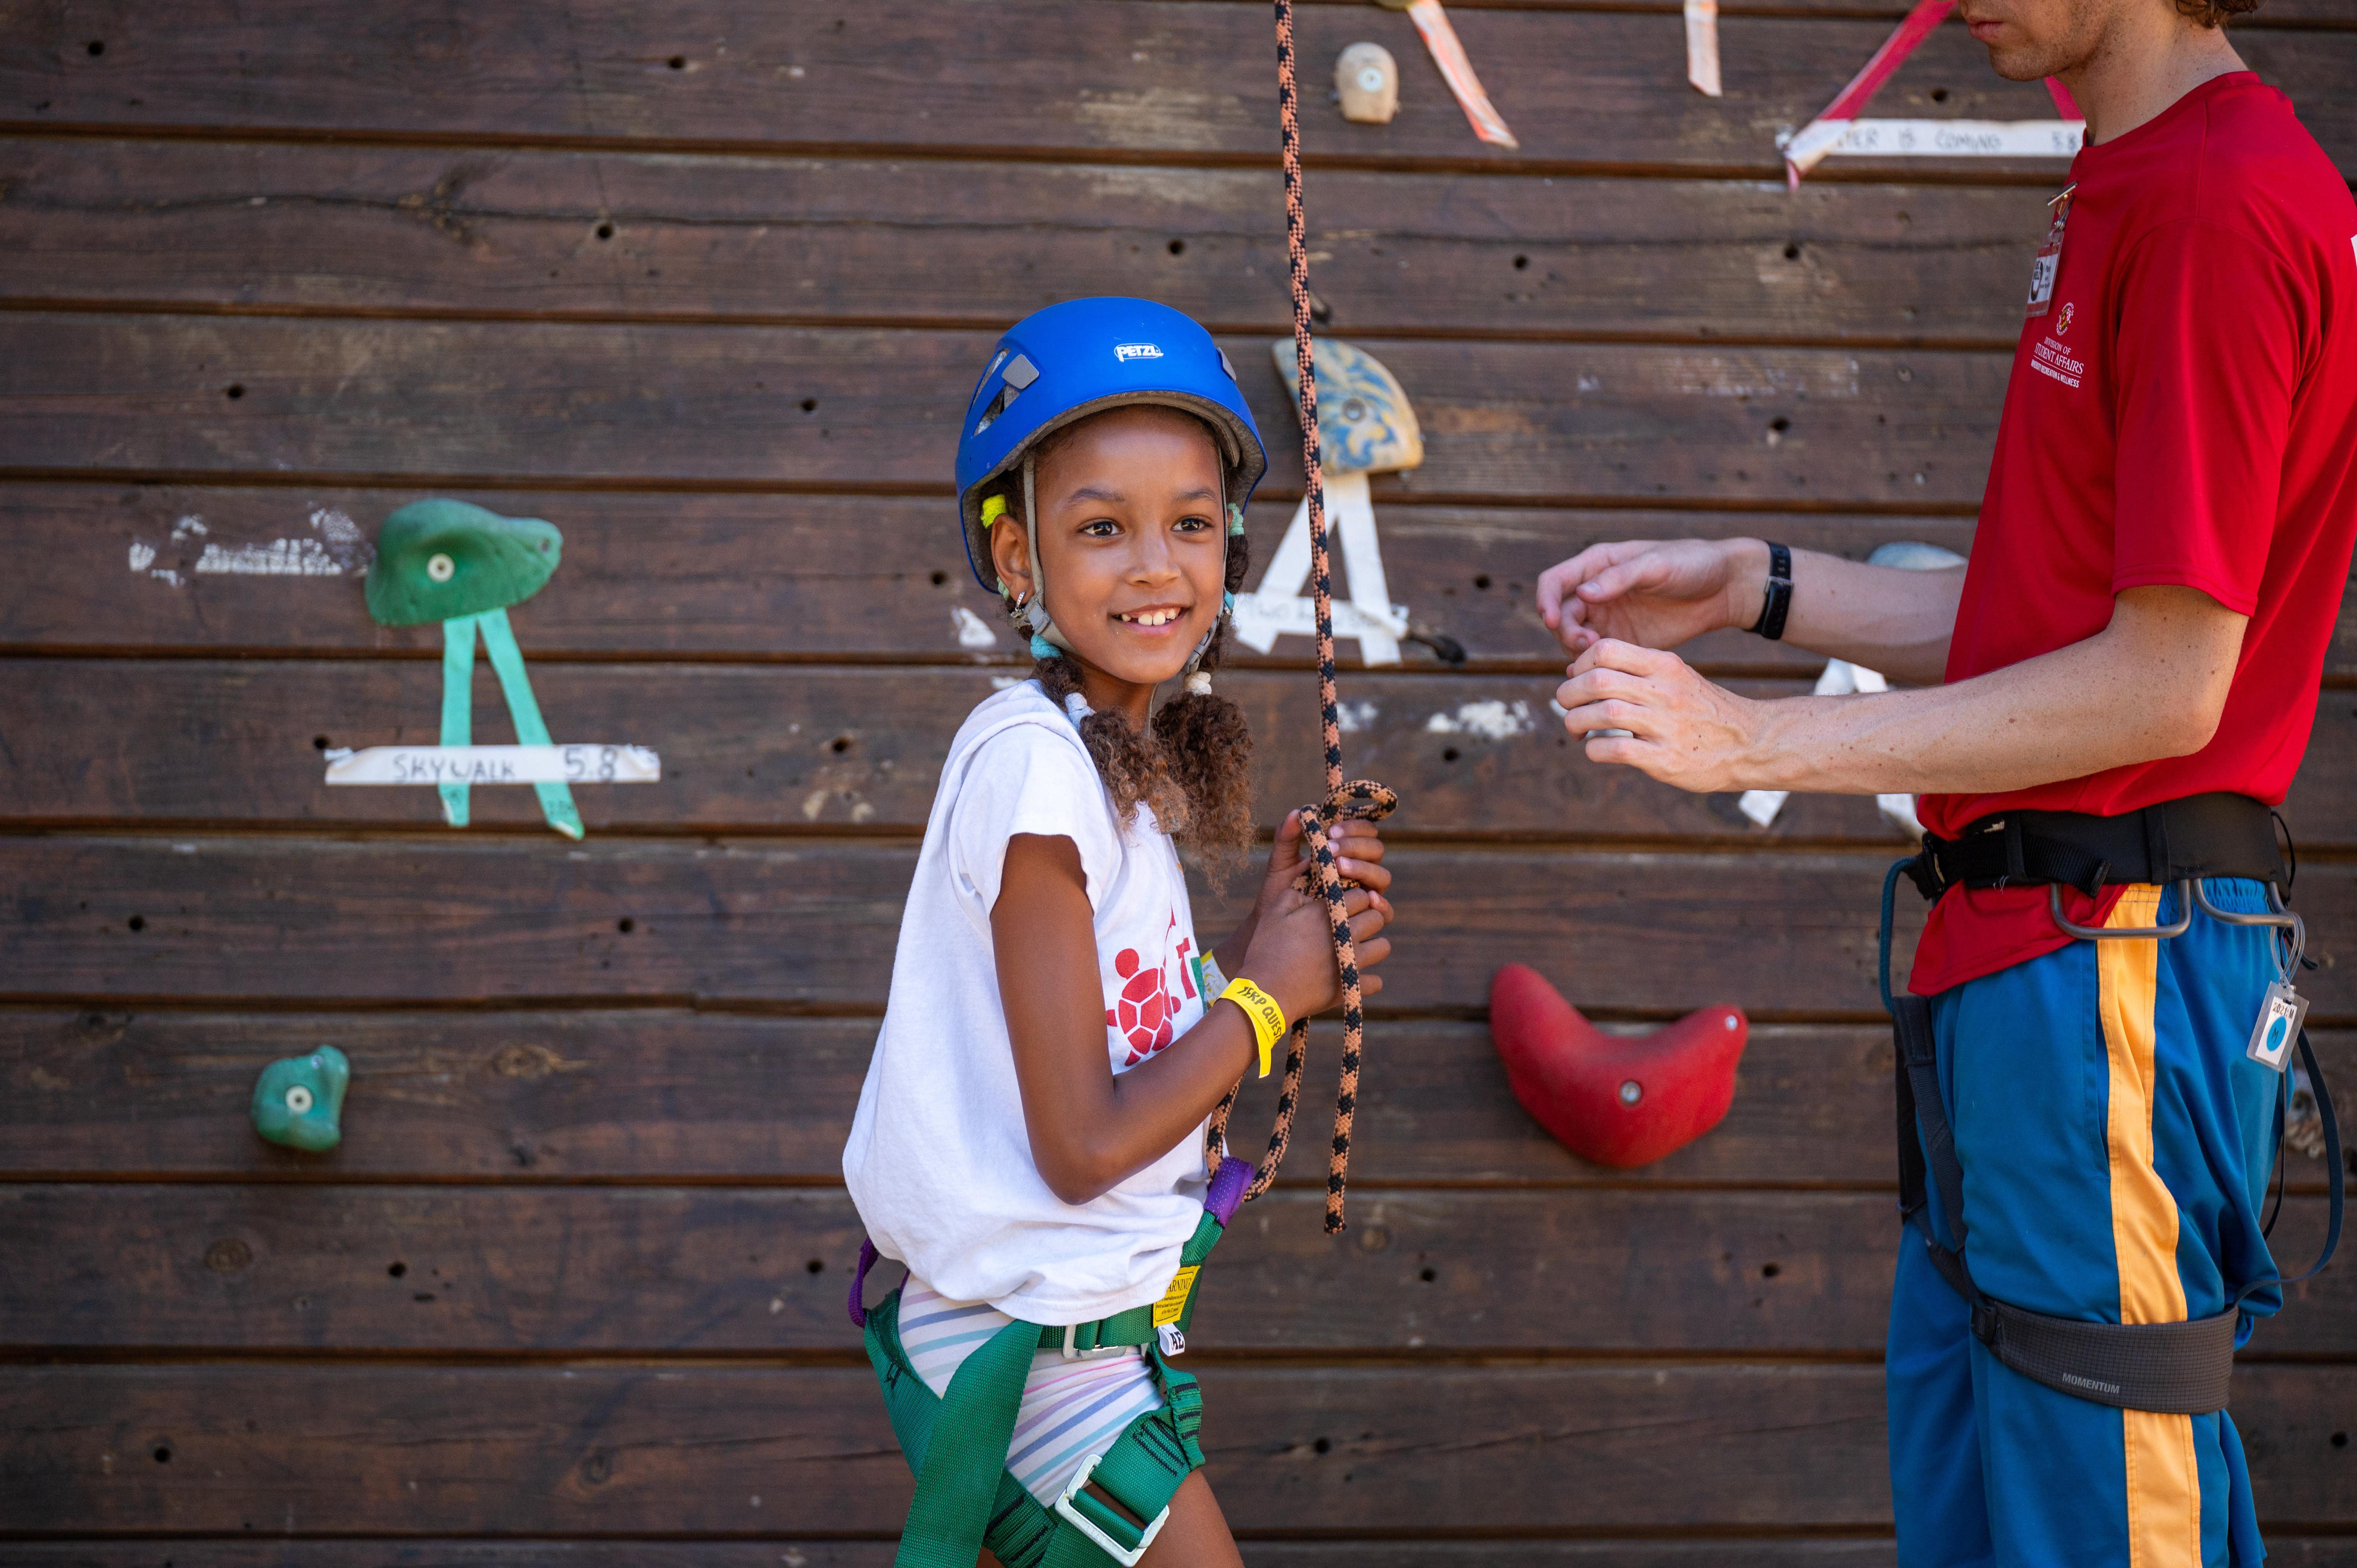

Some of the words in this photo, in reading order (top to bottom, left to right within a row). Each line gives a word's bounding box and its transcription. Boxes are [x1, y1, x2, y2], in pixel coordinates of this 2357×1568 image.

[1116, 345, 1164, 362] PETZL
[2044, 336, 2063, 351] DIVISION
[2063, 346, 2071, 355] OF
[2034, 342, 2056, 362] STUDENT
[2055, 353, 2084, 374] AFFAIRS
[2060, 373, 2080, 388] WELLNESS
[393, 753, 516, 779] SKYWALK
[1237, 986, 1267, 1005] TERP
[2289, 1008, 2294, 1019] M
[2271, 1027, 2279, 1043] M
[1166, 1278, 1191, 1292] ARNING
[2062, 1373, 2120, 1394] MOMENTUM
